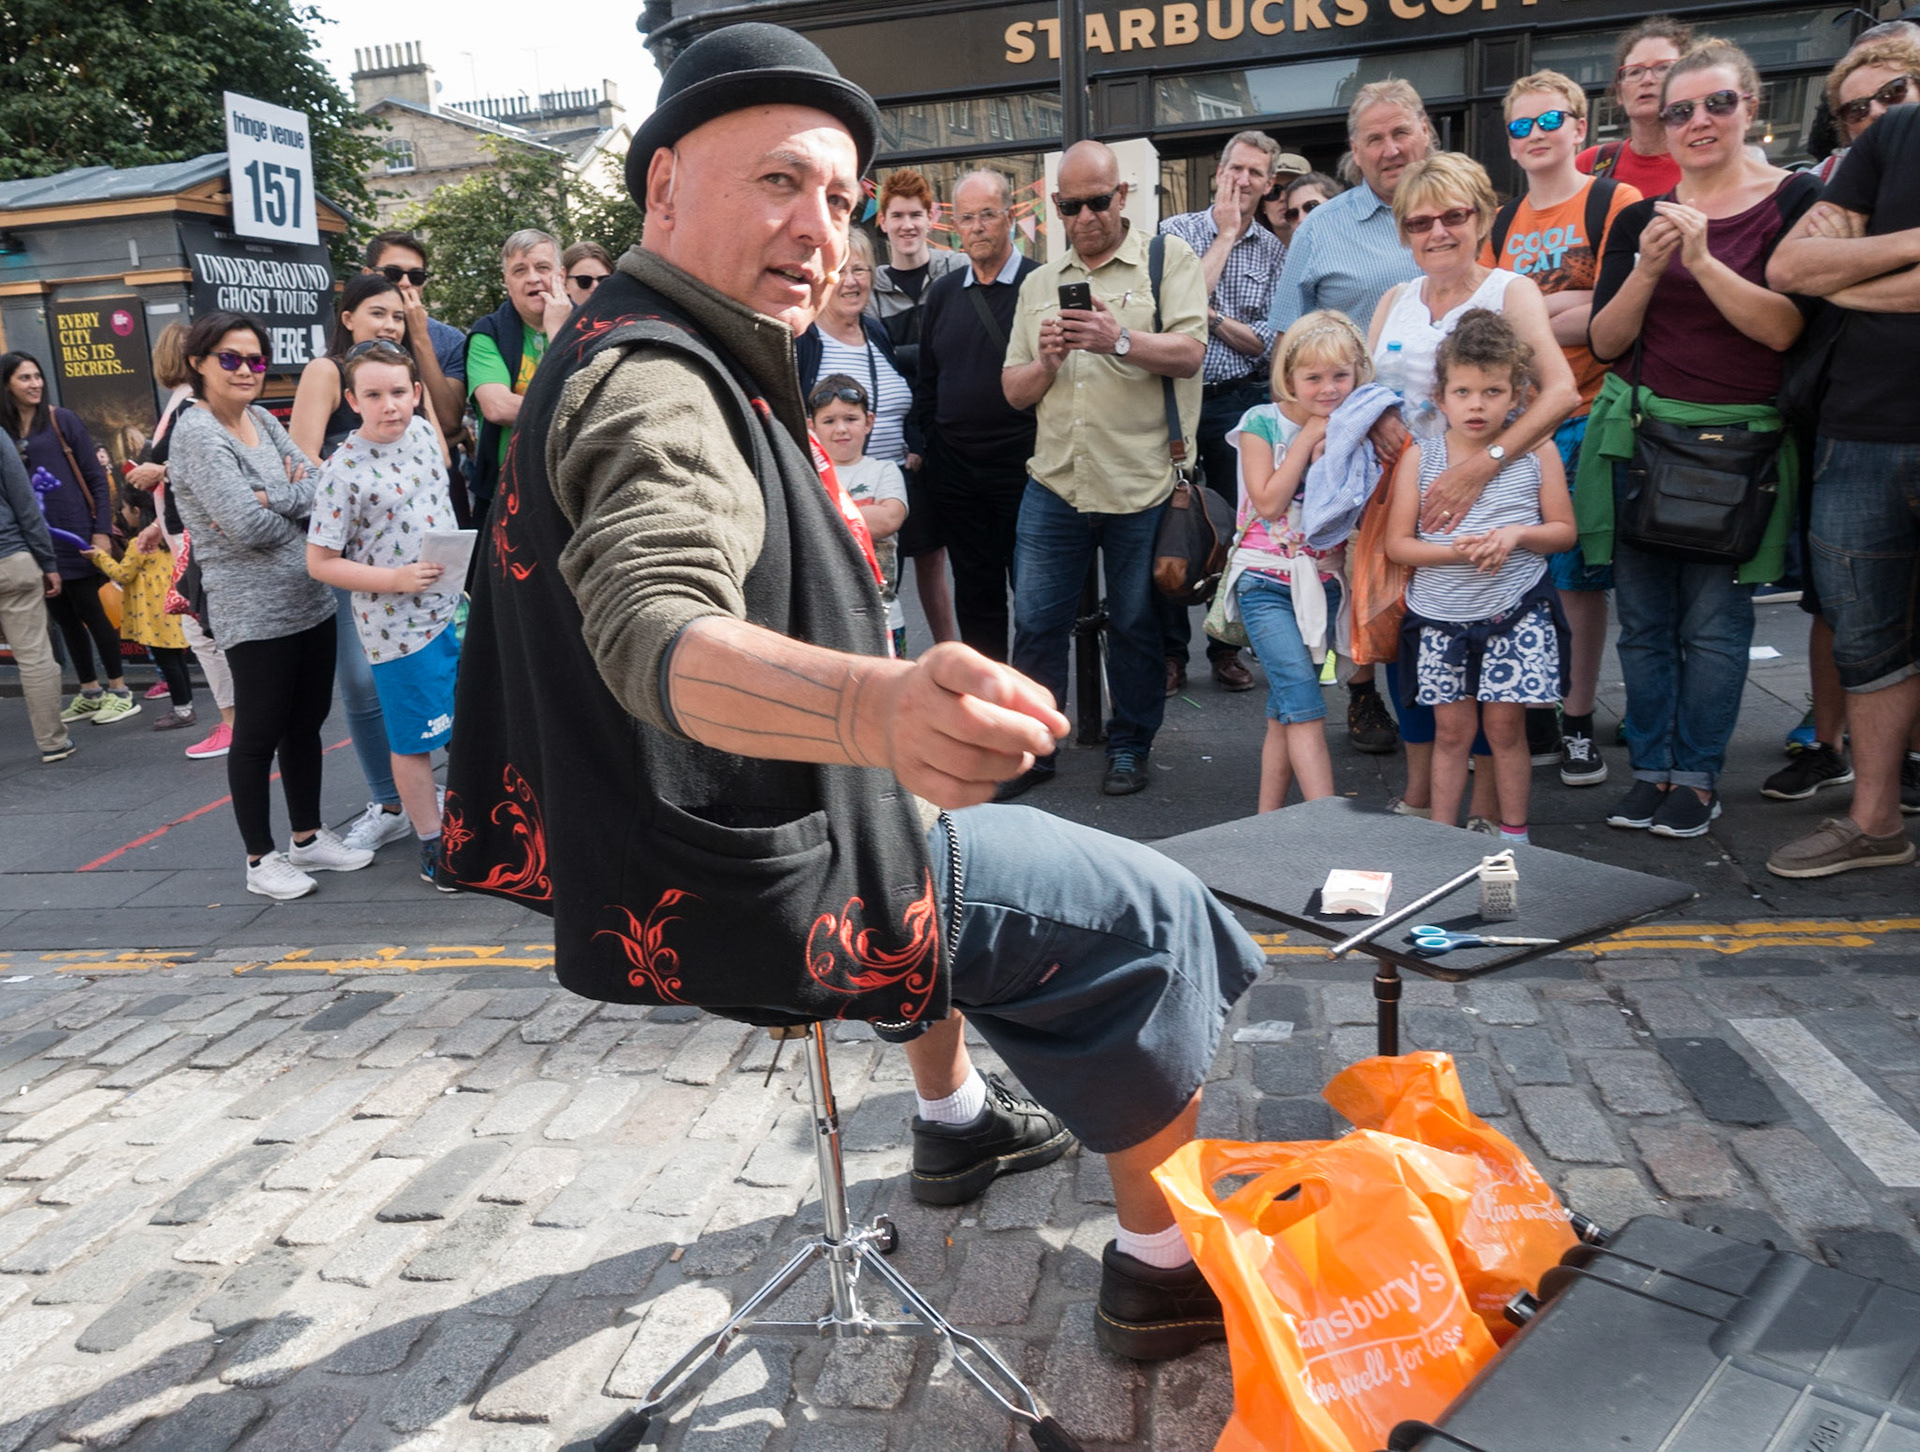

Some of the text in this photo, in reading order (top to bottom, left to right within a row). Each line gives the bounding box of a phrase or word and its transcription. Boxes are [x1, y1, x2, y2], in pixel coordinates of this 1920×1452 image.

[1004, 0, 1369, 64] STARBUCKS
[232, 110, 305, 150] fringe venue
[244, 159, 302, 229] 157
[1507, 224, 1584, 255] COOL
[194, 253, 330, 291] UNDERGROUND
[1513, 246, 1569, 275] CAT
[217, 286, 319, 315] GHOST TOURS
[57, 311, 100, 330] EVERY
[59, 328, 92, 346] CITY
[62, 343, 116, 361] HAS ITS
[64, 359, 135, 378] SECRETS...
[1296, 1259, 1447, 1349] ainsbury's
[1340, 1347, 1393, 1397] well
[1391, 1341, 1425, 1388] for
[1418, 1325, 1464, 1359] less
